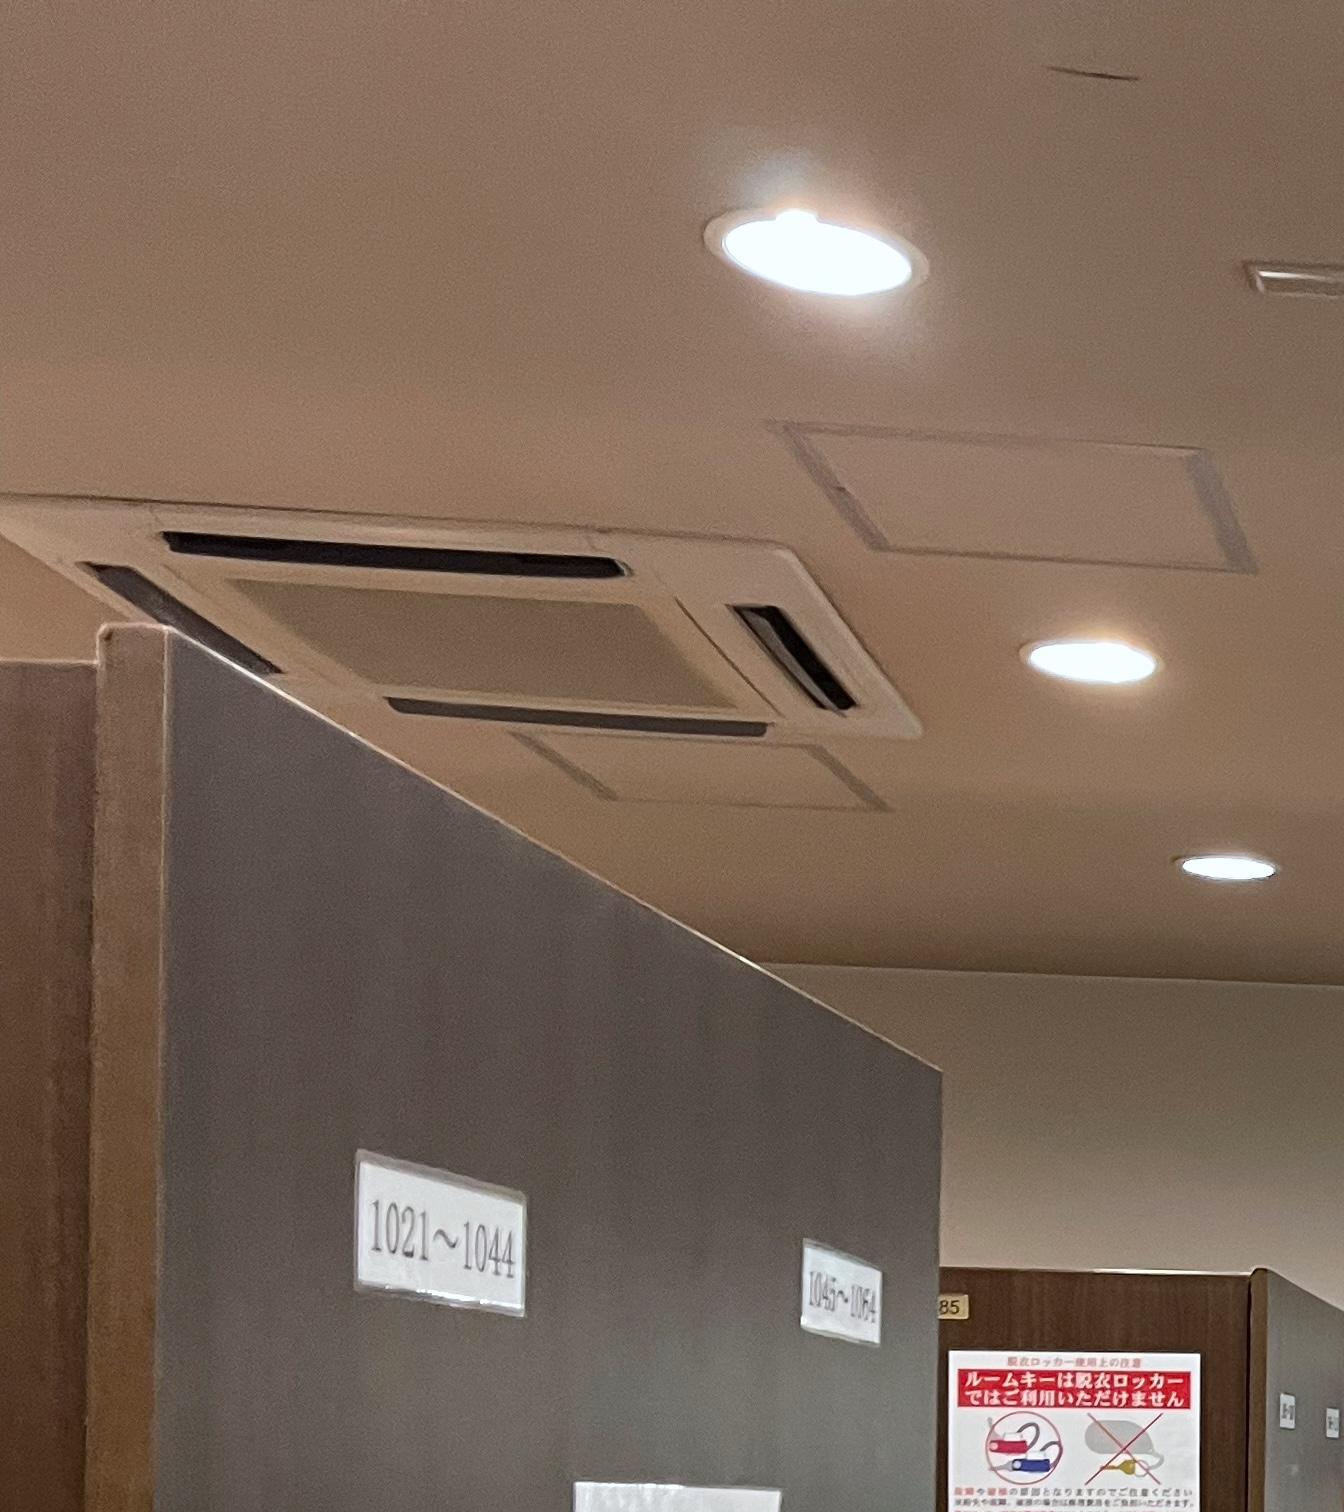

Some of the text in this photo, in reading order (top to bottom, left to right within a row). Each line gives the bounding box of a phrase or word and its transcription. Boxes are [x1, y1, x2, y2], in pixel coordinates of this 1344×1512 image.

[940, 1300, 960, 1315] 85
[965, 1371, 1185, 1390] ルームキーは脱衣ロッカー
[964, 1389, 1185, 1409] ではご利用いただけません
